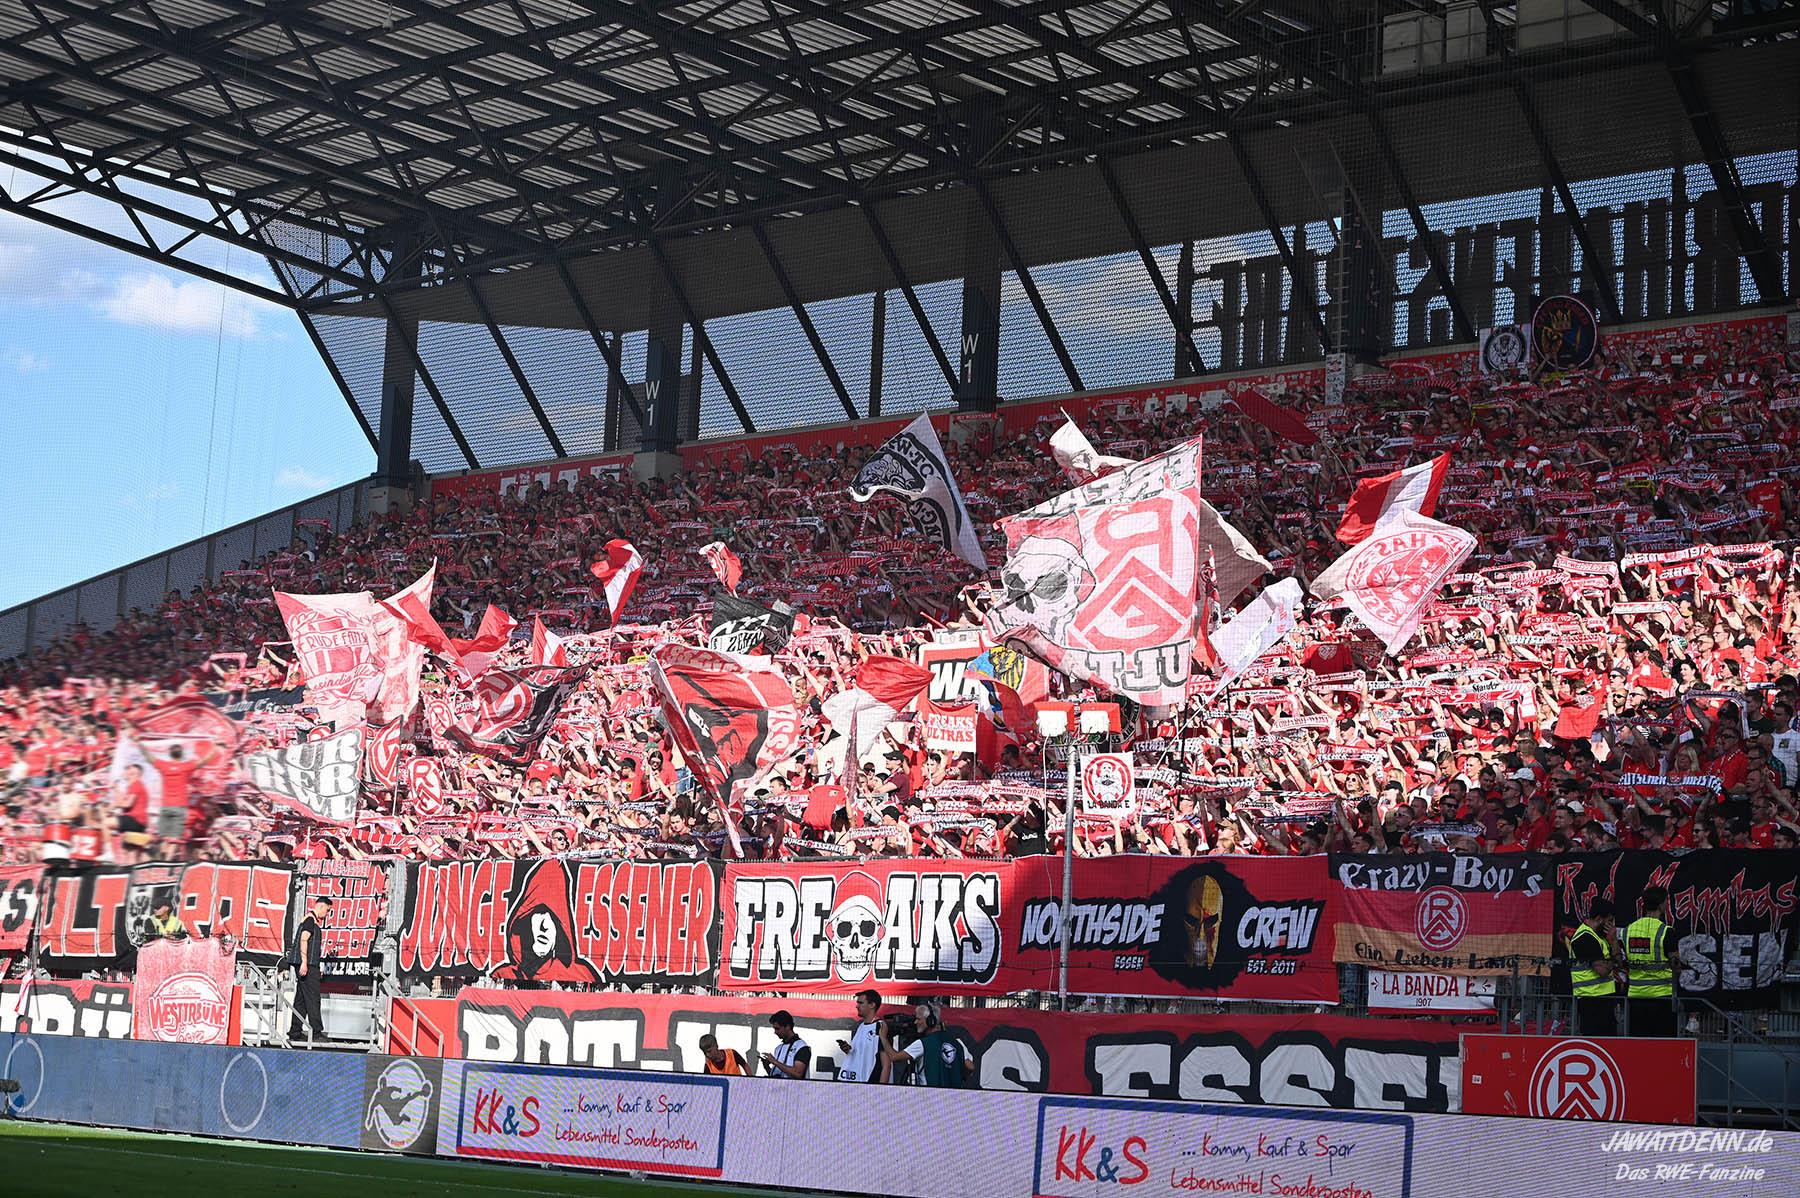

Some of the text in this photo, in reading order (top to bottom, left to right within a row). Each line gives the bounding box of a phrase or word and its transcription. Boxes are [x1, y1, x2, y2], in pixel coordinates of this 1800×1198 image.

[962, 334, 979, 355] W
[964, 360, 973, 383] 1
[645, 380, 660, 400] W
[647, 404, 655, 426] 1
[305, 634, 339, 650] RUDE
[928, 713, 974, 728] FREAKS
[927, 728, 974, 743] ULTRAS
[1088, 800, 1098, 809] LA
[1100, 799, 1122, 809] BANDA
[1339, 856, 1543, 899] Crazy-Boy's
[400, 860, 714, 976] JUNGE ESSENER
[731, 873, 1001, 982] FREAKS
[1237, 907, 1318, 949] CREW
[1114, 955, 1295, 975] ESSEN EST. 2011
[1383, 974, 1400, 996] LA
[1404, 974, 1460, 997] BANDA
[1416, 998, 1432, 1008] 1907
[473, 1087, 541, 1137] KK&S
[616, 1093, 642, 1113] Kauf
[645, 1101, 653, 1113] &
[657, 1094, 687, 1128] Spar
[555, 1122, 698, 1159] Lebensmittel Sonderposten
[1054, 1126, 1149, 1184] KK&S
[1257, 1132, 1290, 1157] Kauf
[1297, 1140, 1308, 1157] &
[1315, 1134, 1355, 1176] Spar
[1171, 1167, 1372, 1198] Lebensmittel Sonderposten
